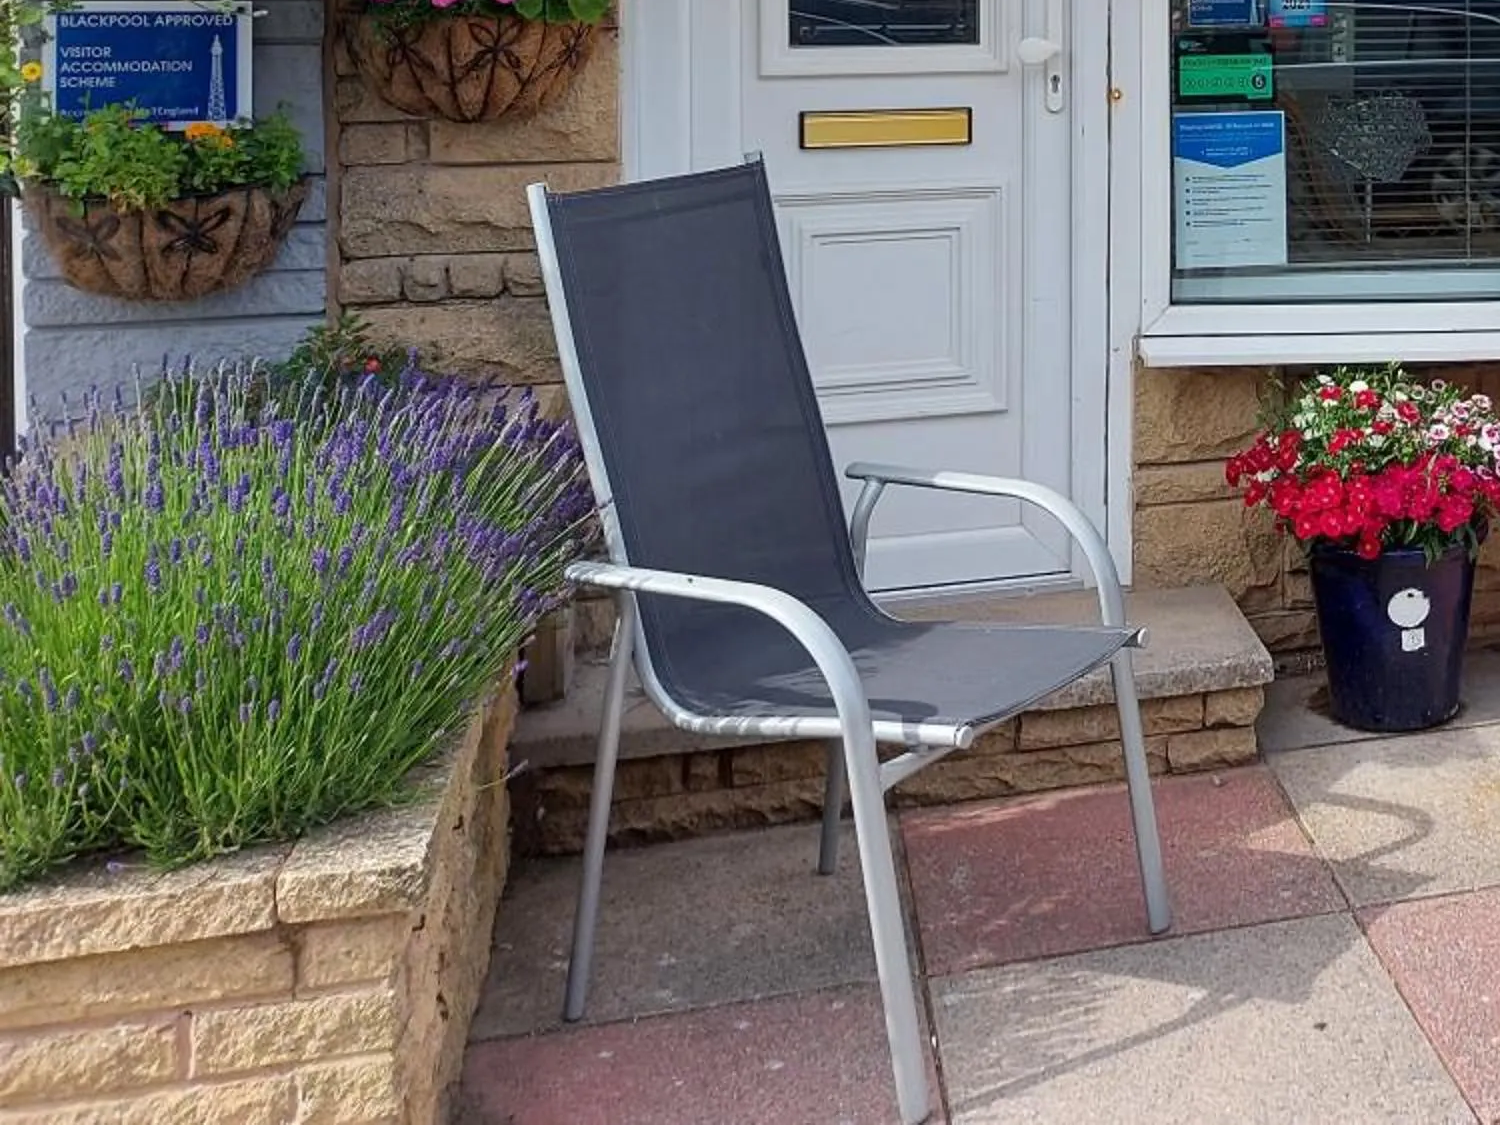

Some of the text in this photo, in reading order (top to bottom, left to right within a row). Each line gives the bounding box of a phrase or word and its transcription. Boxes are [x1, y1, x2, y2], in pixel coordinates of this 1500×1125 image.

[59, 13, 234, 29] BLACKPOOL APPROVED
[59, 46, 112, 59] VISITOR
[59, 60, 193, 74] ACCOMMODATION
[59, 77, 116, 89] SCHEME
